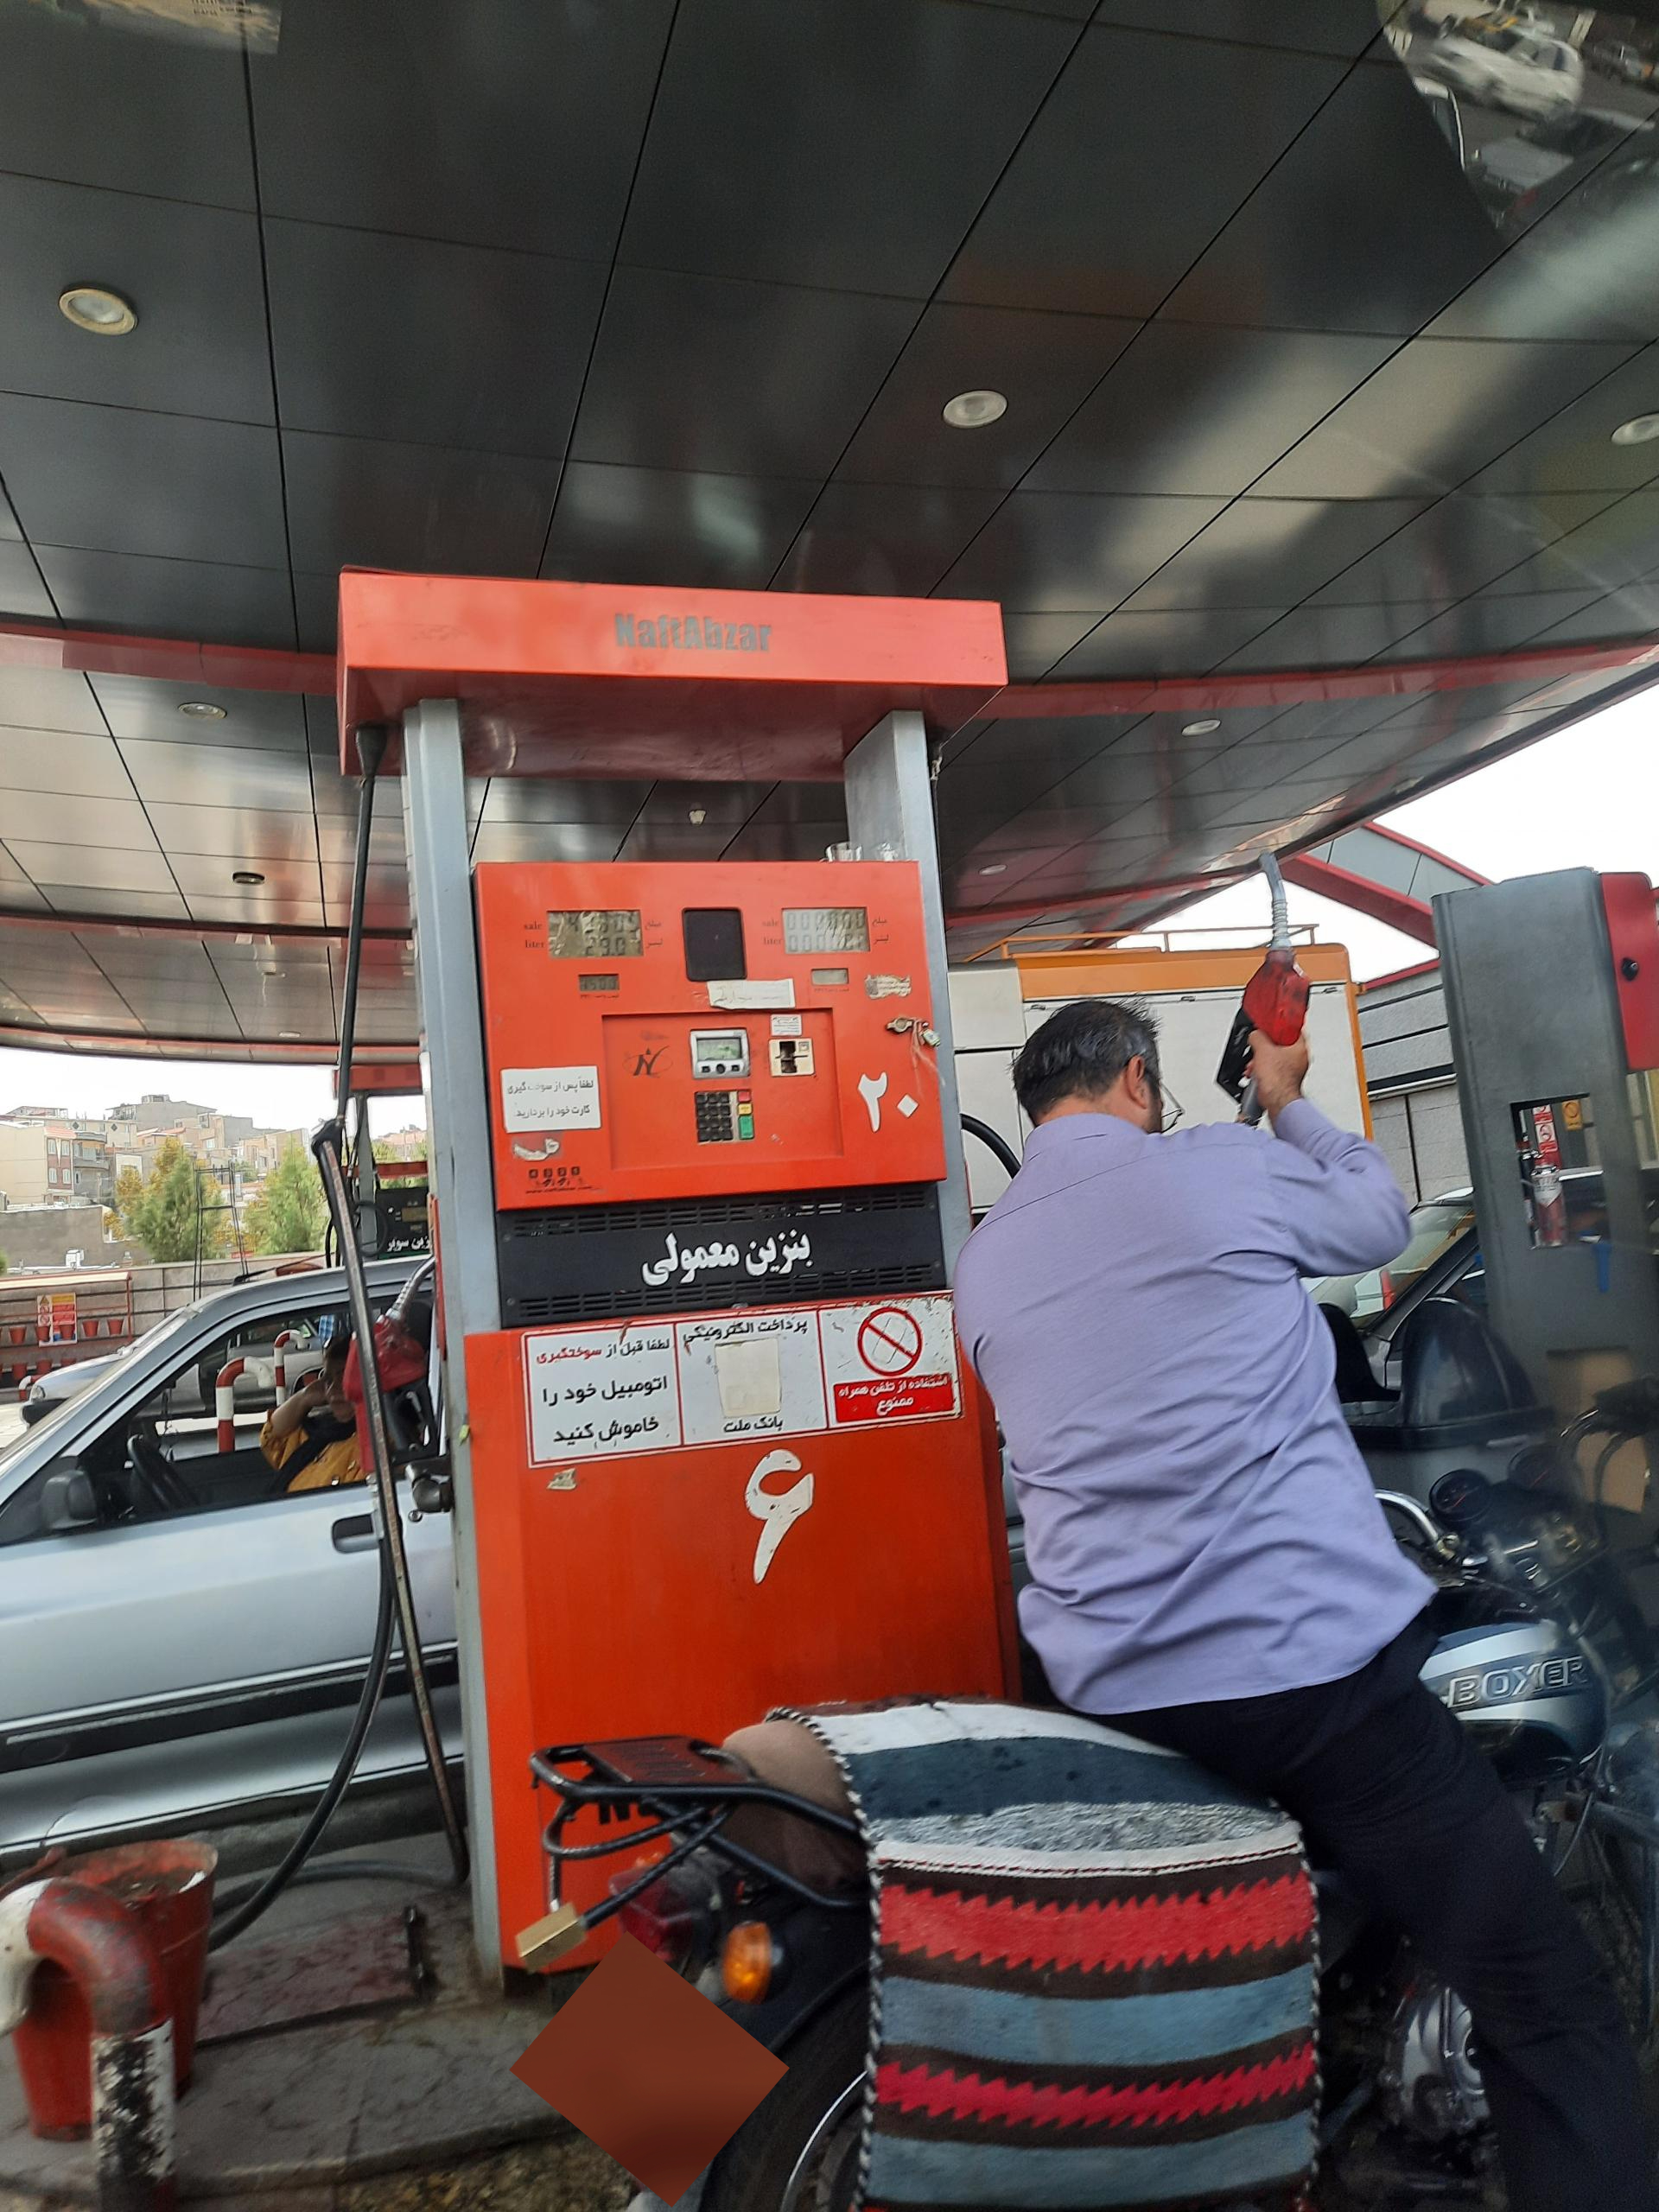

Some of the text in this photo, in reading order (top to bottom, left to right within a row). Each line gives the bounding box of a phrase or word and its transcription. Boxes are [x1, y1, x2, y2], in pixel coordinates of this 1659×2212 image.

[613, 613, 772, 652] NaftAbzar
[524, 920, 543, 931] sale
[524, 939, 545, 949] liter
[553, 1079, 561, 1092] از
[546, 1107, 554, 1118] را
[556, 1105, 570, 1117] خود
[642, 1229, 814, 1286] بنزین معمولی
[758, 1318, 808, 1334] پرداخت
[606, 1344, 617, 1357] از
[620, 1340, 643, 1357] قبل
[647, 1338, 670, 1351] لطفا
[897, 1380, 906, 1394] از
[908, 1375, 949, 1389] استفاده
[543, 1376, 668, 1407] اتومبیل خود را
[838, 1385, 869, 1400] همراه
[877, 1396, 914, 1415] ممنوع
[554, 1416, 659, 1446] خاموش کنید
[723, 1416, 784, 1433] بانک ملت
[745, 1449, 814, 1584] ۶
[1447, 1656, 1588, 1708] BOXER
